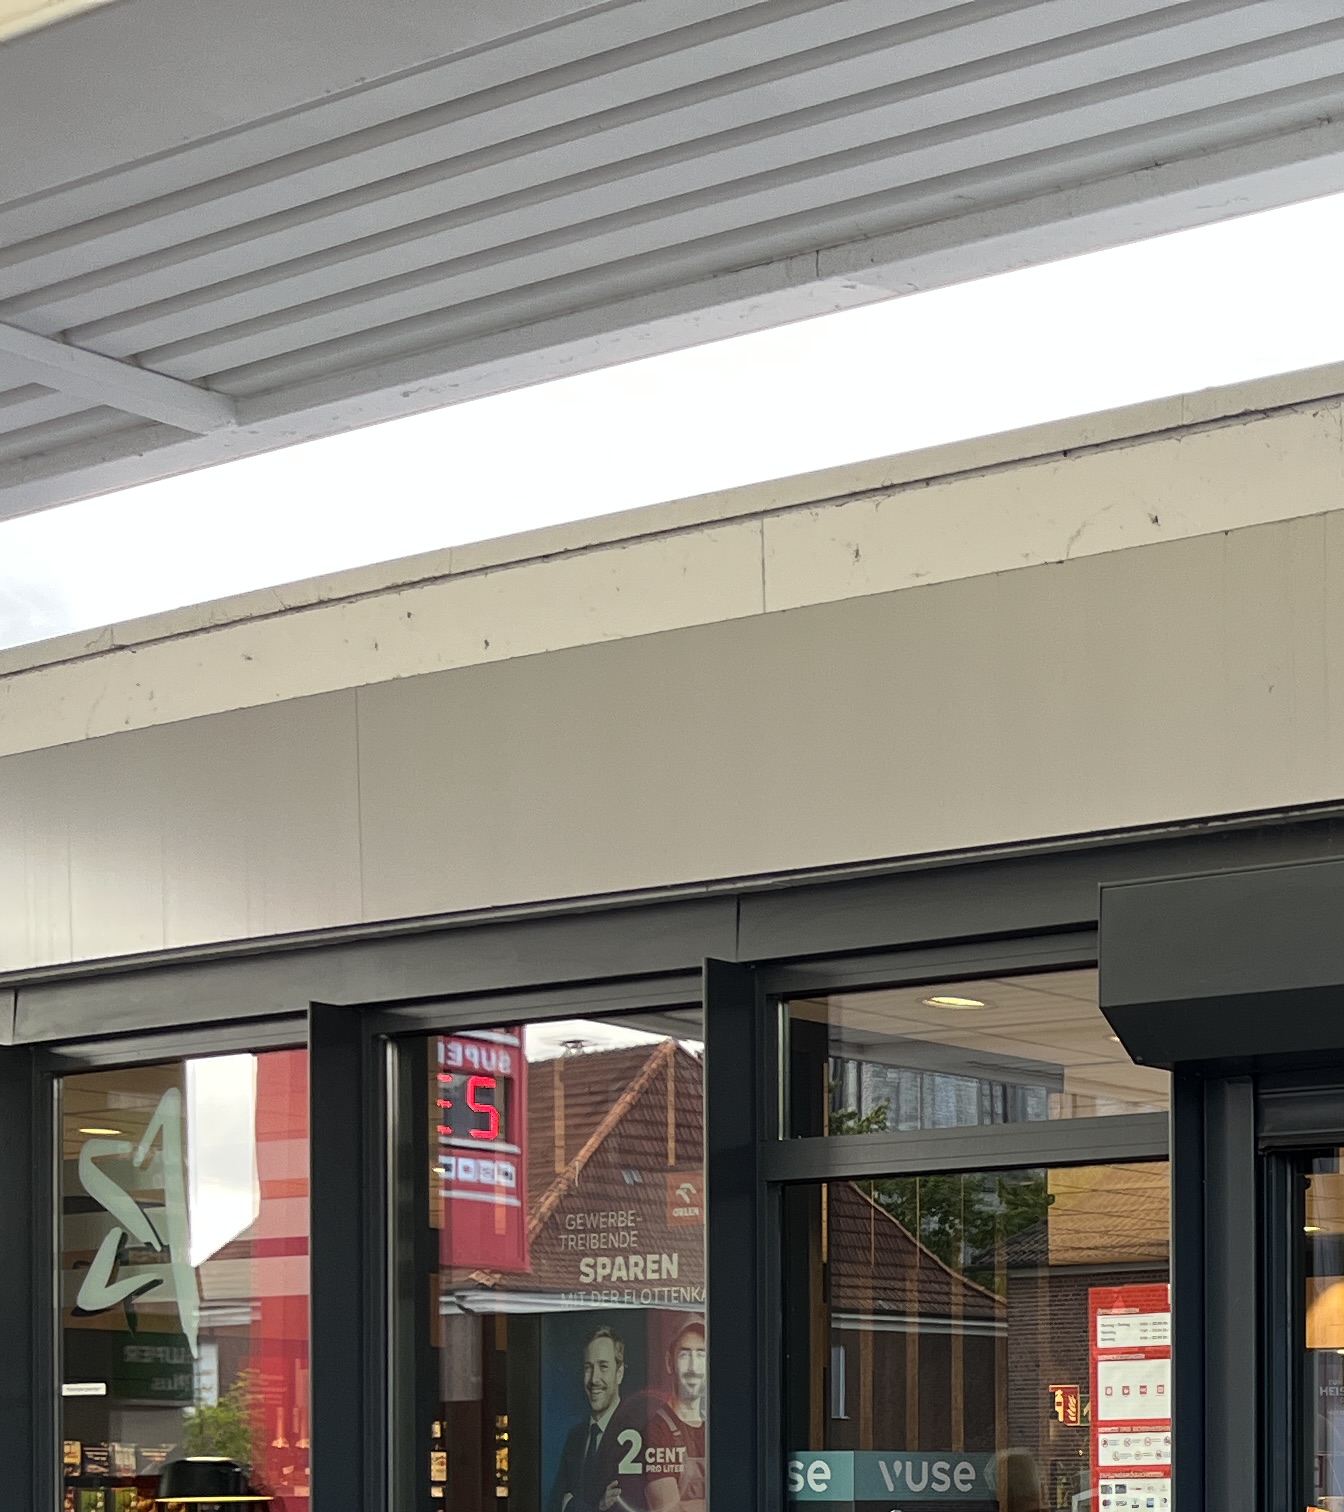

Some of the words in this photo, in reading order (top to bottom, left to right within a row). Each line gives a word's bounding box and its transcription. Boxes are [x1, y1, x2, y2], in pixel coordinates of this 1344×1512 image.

[565, 1210, 643, 1230] GEWERBE-
[559, 1231, 639, 1250] TREIBENDE
[579, 1253, 679, 1283] SPAREN
[617, 1429, 643, 1475] 2
[645, 1446, 687, 1463] CENT
[646, 1464, 662, 1473] PRO
[663, 1464, 685, 1473] LITER
